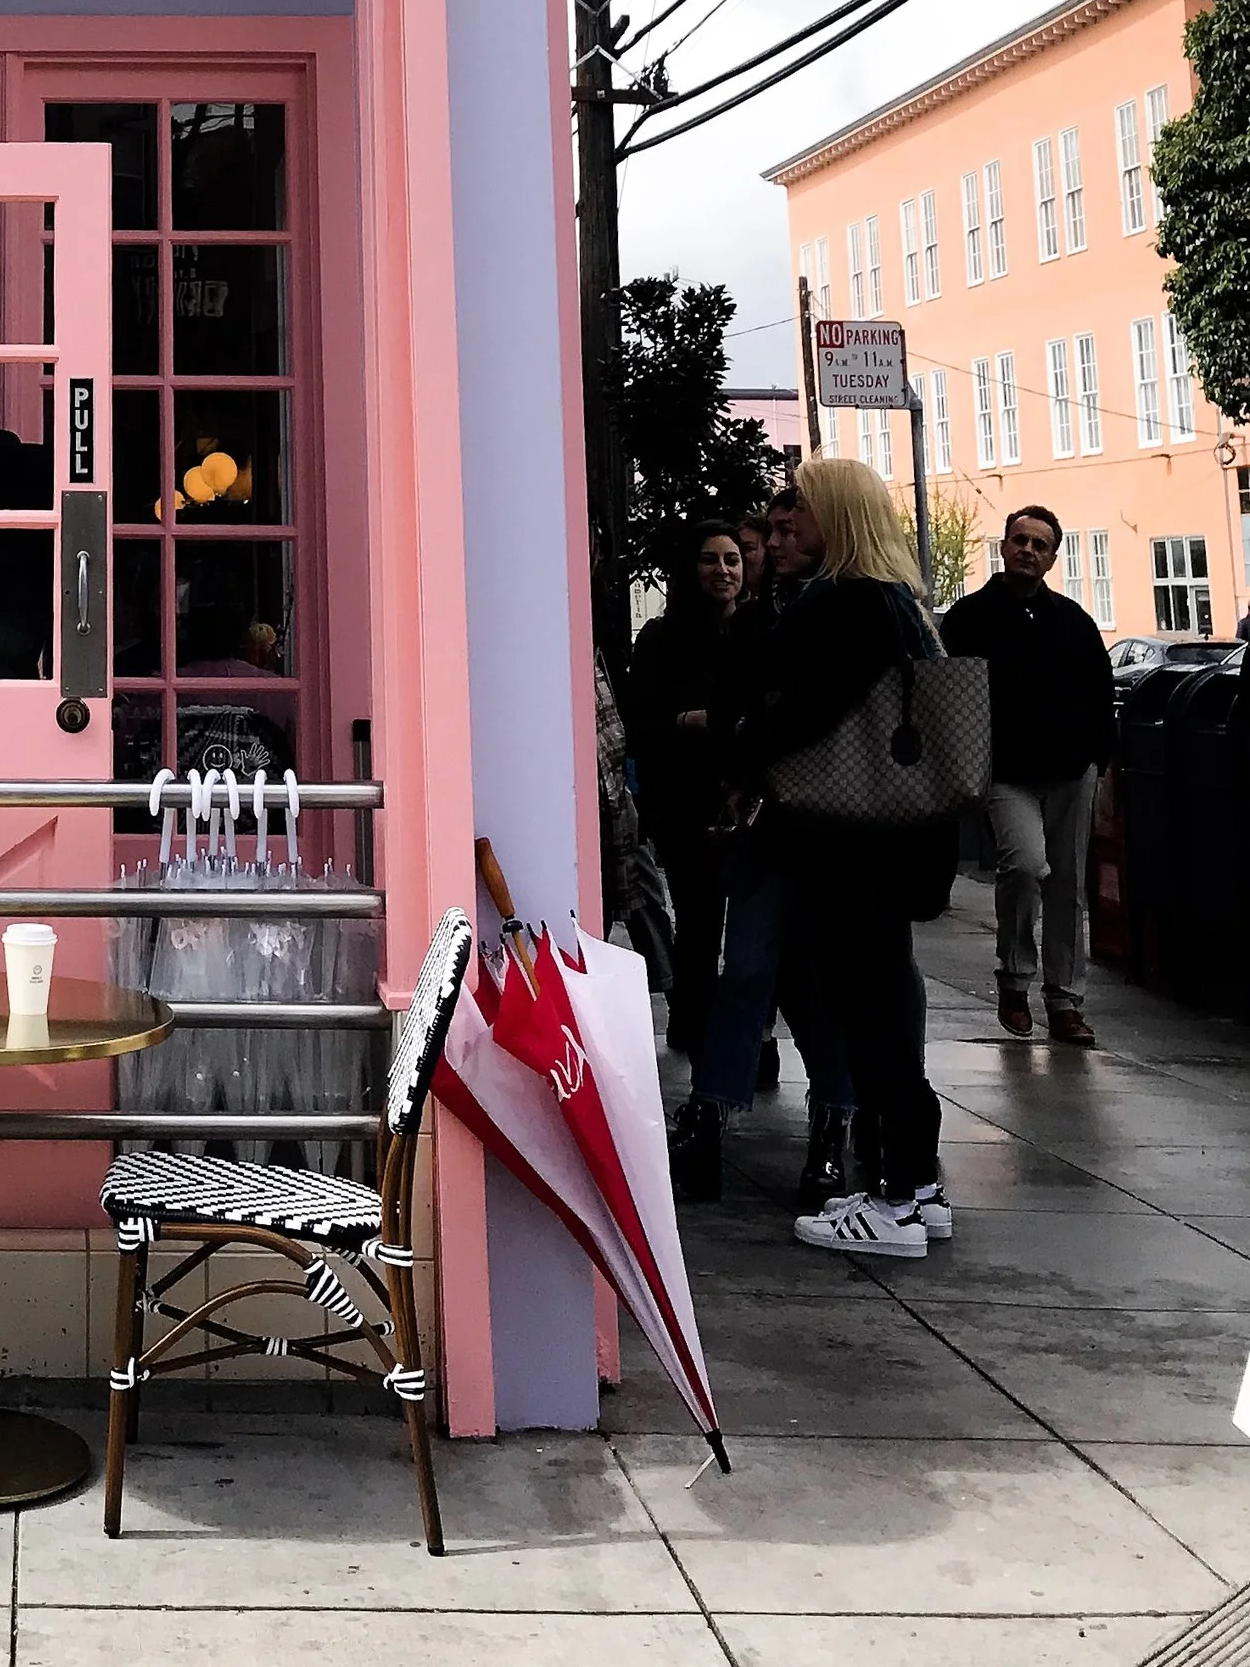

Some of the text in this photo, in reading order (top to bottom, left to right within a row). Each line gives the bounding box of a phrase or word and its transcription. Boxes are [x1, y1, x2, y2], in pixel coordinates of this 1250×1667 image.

[819, 324, 899, 346] NO PARKING
[832, 374, 890, 389] TUESDAY
[829, 394, 857, 404] STREET
[74, 387, 89, 474] PULL
